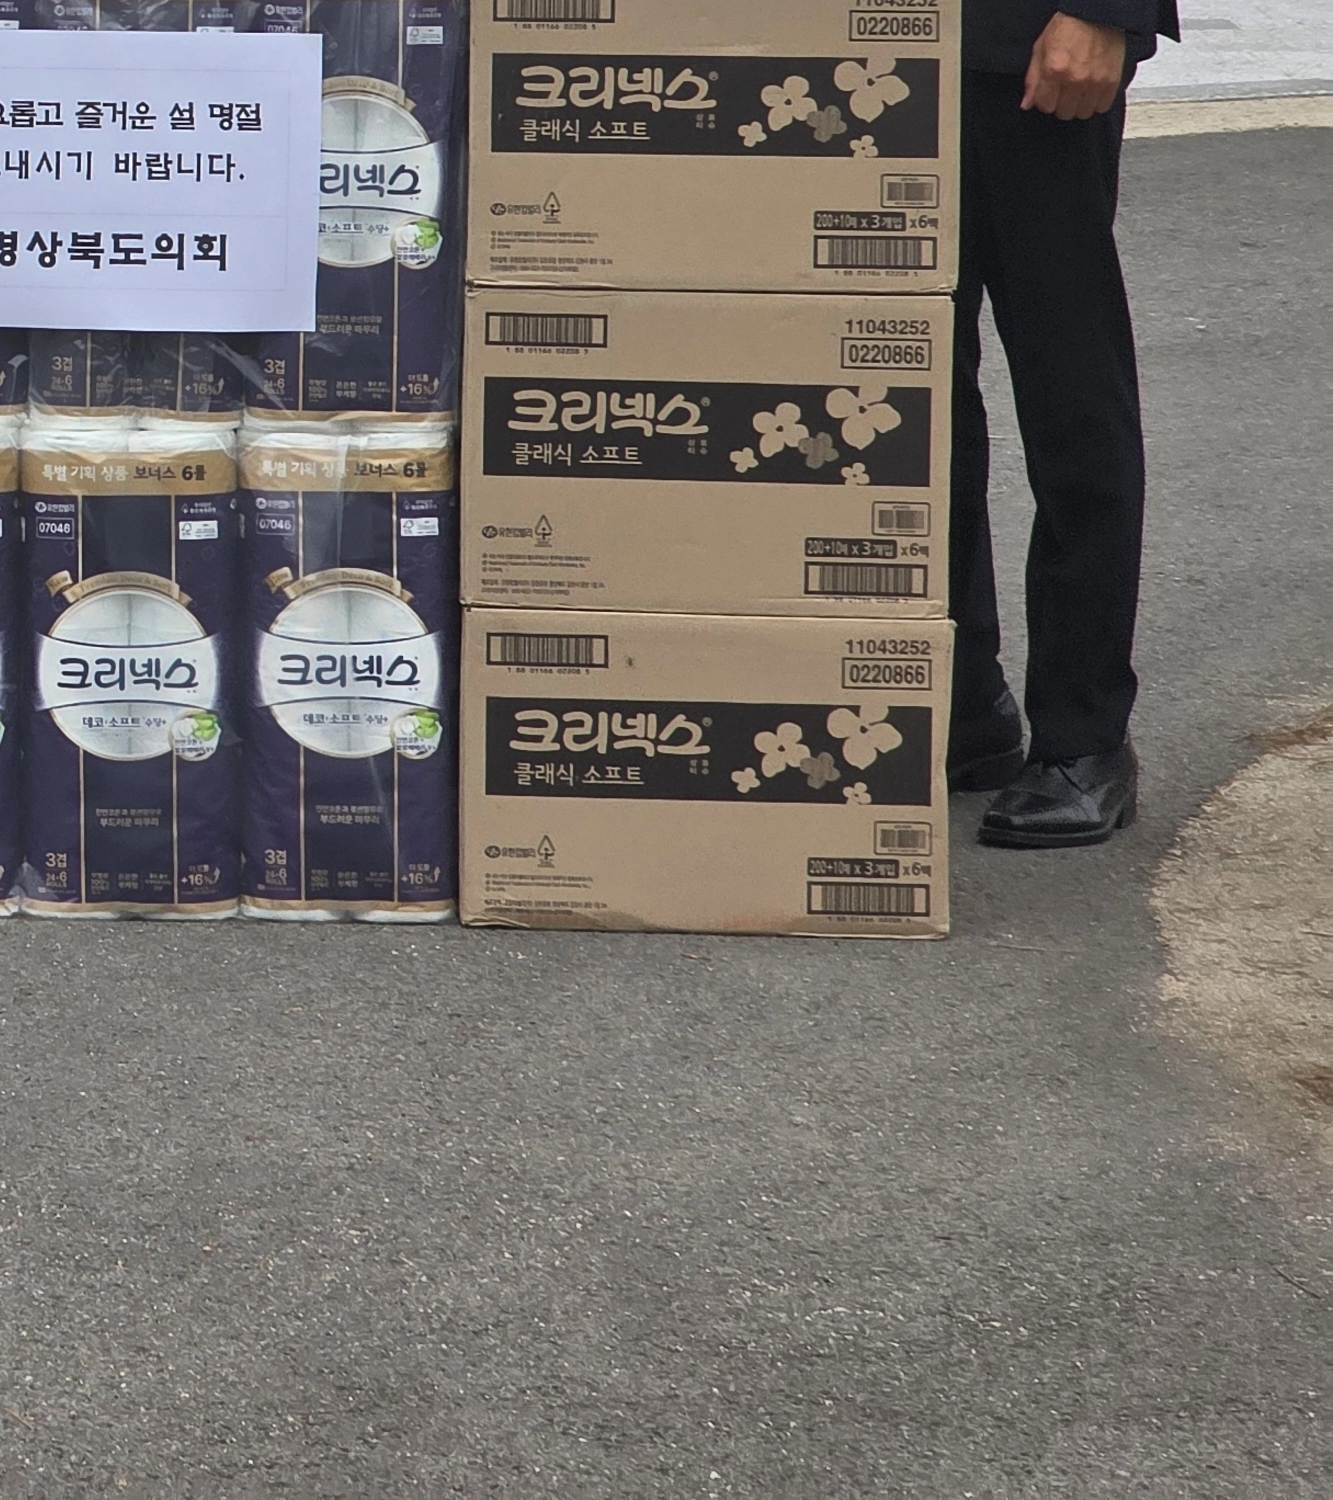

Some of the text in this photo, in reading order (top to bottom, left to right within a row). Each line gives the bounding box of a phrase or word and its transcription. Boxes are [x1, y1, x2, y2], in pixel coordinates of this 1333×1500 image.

[856, 16, 933, 37] 0220866
[515, 65, 718, 112] 크리넥스
[74, 101, 157, 131] 즐거운
[168, 102, 196, 131] 설
[208, 102, 263, 132] 명절
[519, 118, 651, 142] 클래식 소프트
[114, 151, 246, 183] 바랍니다.
[319, 165, 422, 198] 리넥스
[844, 319, 930, 336] 11043252
[848, 343, 925, 365] 0220866
[507, 389, 709, 437] 크리넥스
[511, 442, 643, 466] 클래식 소프트
[39, 522, 71, 534] 07046
[845, 639, 931, 656] 11043252
[57, 657, 200, 691] 크리넥스
[276, 653, 422, 689] 크리넥스
[849, 664, 925, 685] 0220866
[509, 709, 711, 757] 크리넥스
[513, 762, 645, 786] 클래식 소프트
